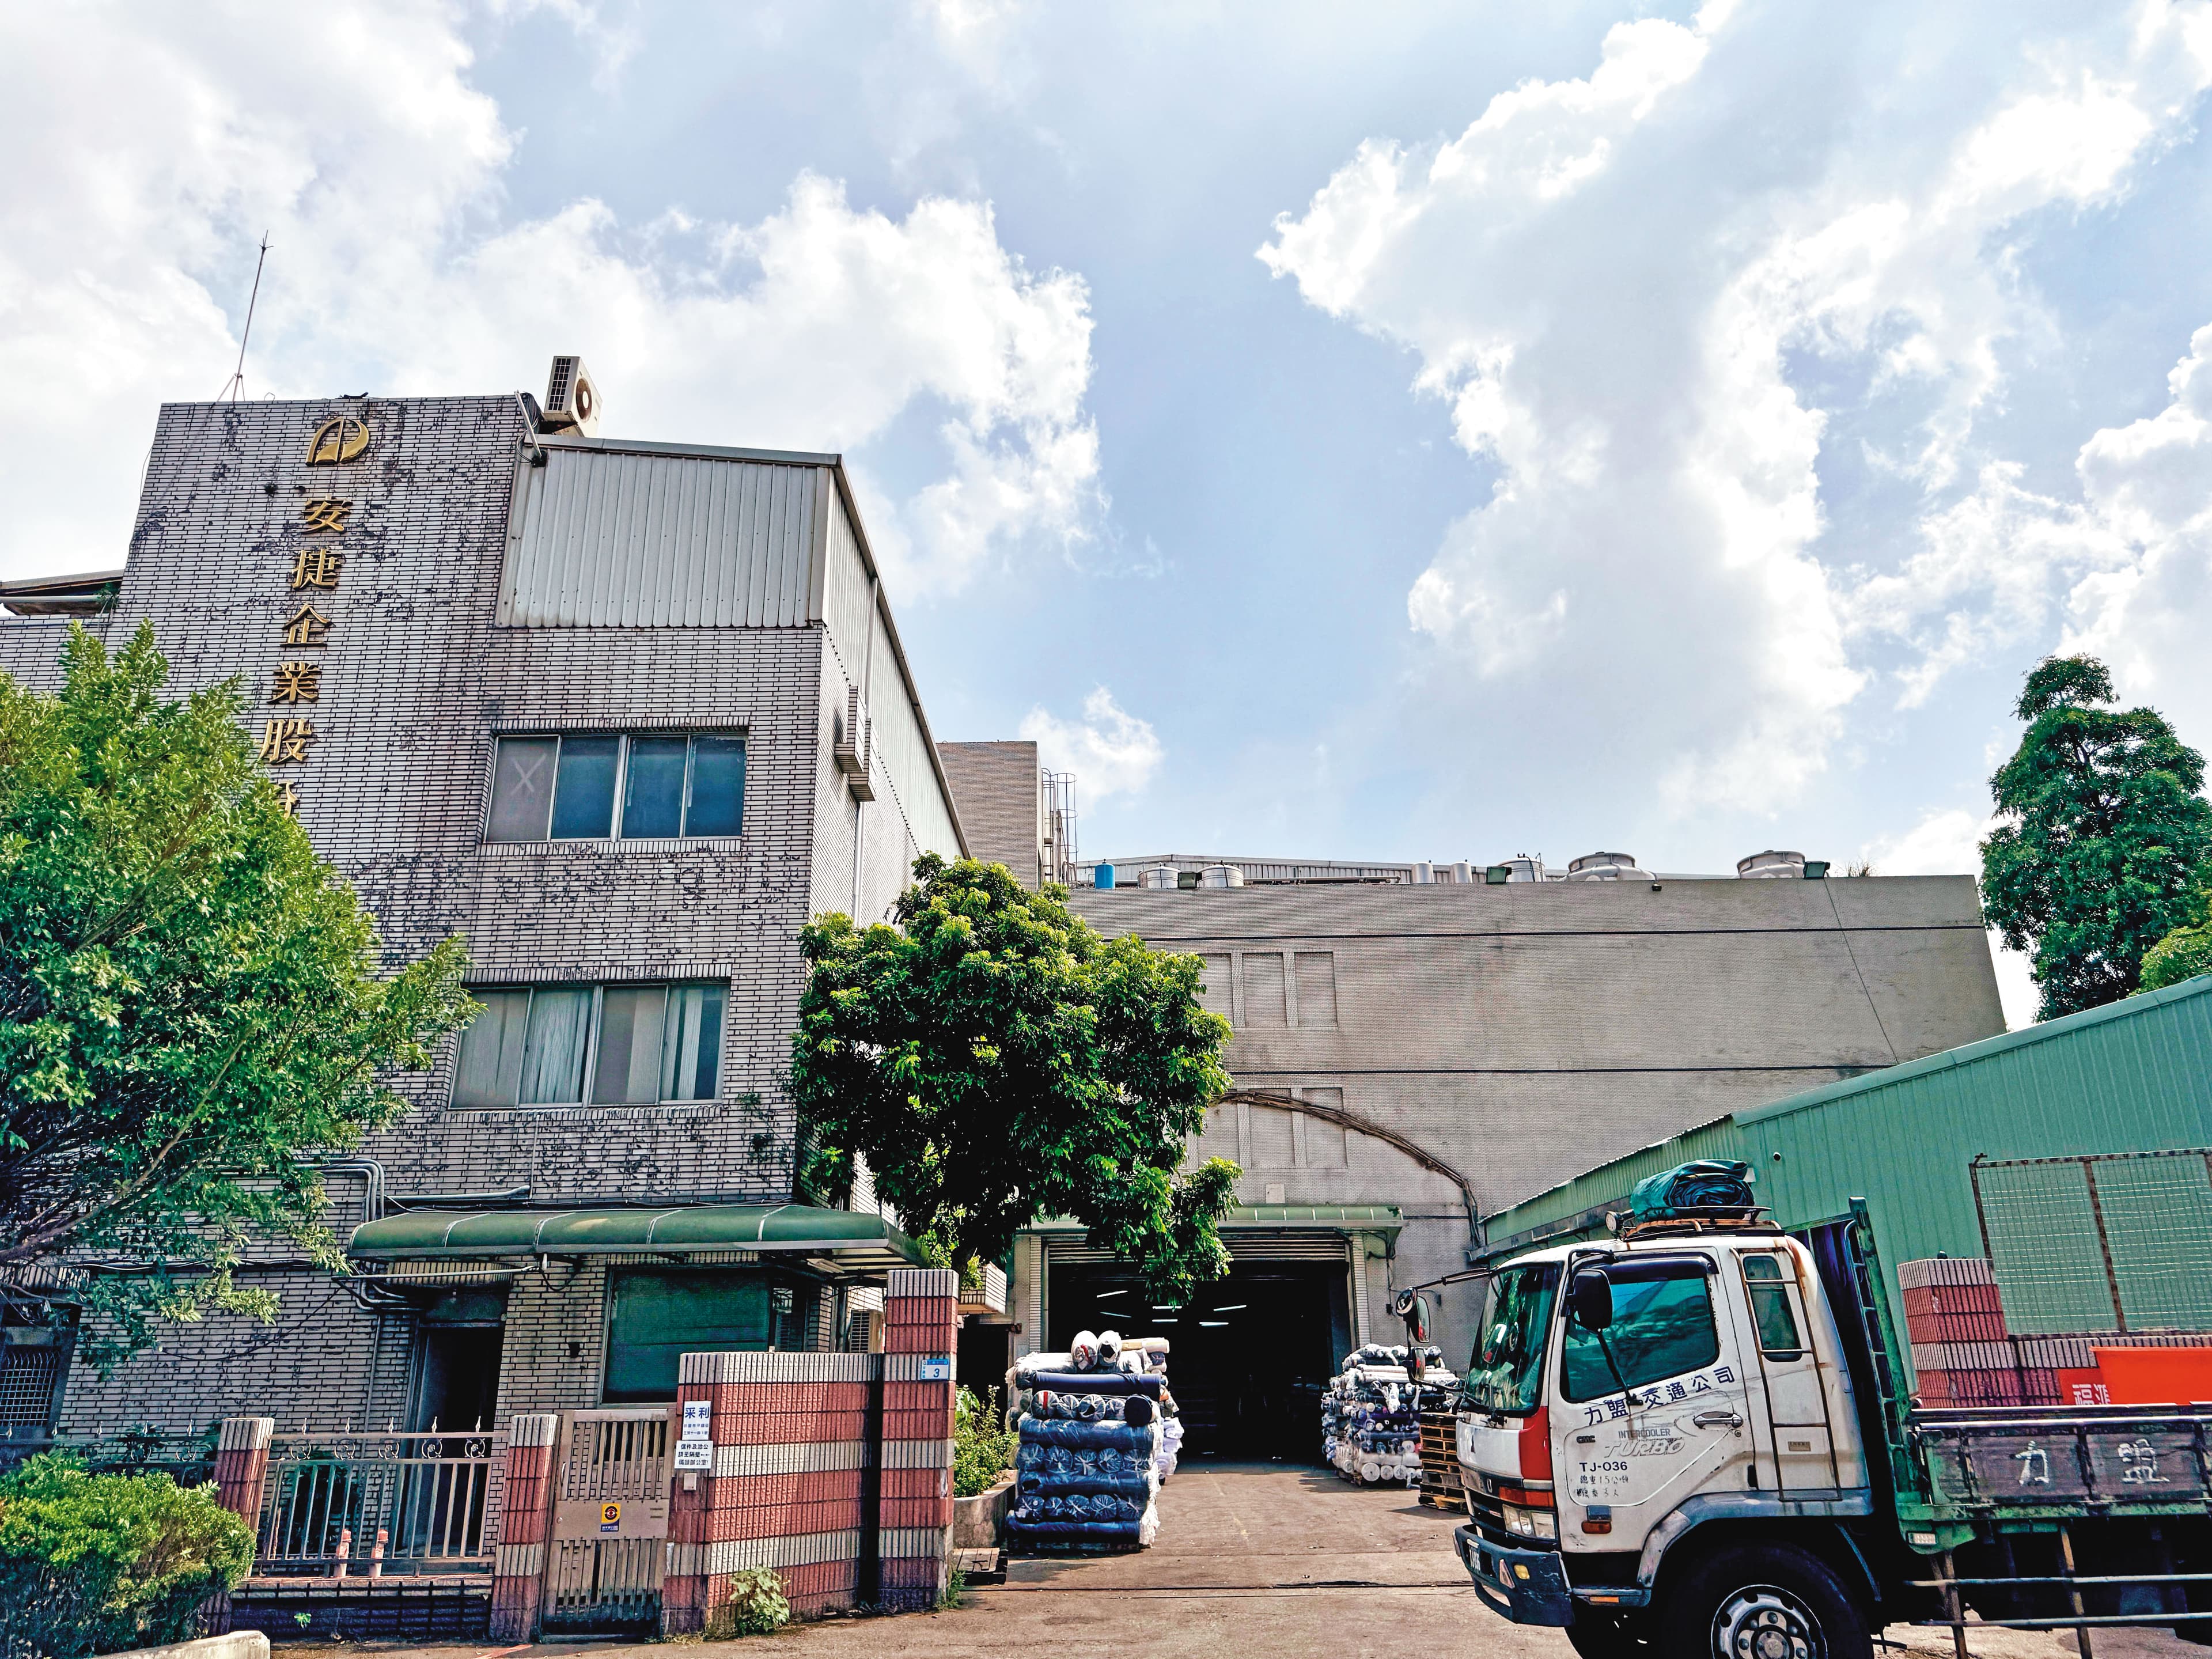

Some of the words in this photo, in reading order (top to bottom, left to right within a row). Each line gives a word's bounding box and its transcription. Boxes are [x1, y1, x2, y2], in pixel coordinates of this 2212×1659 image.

[933, 1368, 940, 1378] 3
[1584, 1366, 1735, 1426] 力盟交通公司
[685, 1407, 710, 1419] 采利
[1618, 1428, 1671, 1438] INTERCOOLER
[1604, 1437, 1685, 1459] TURBO
[1579, 1461, 1628, 1472] TJ-036
